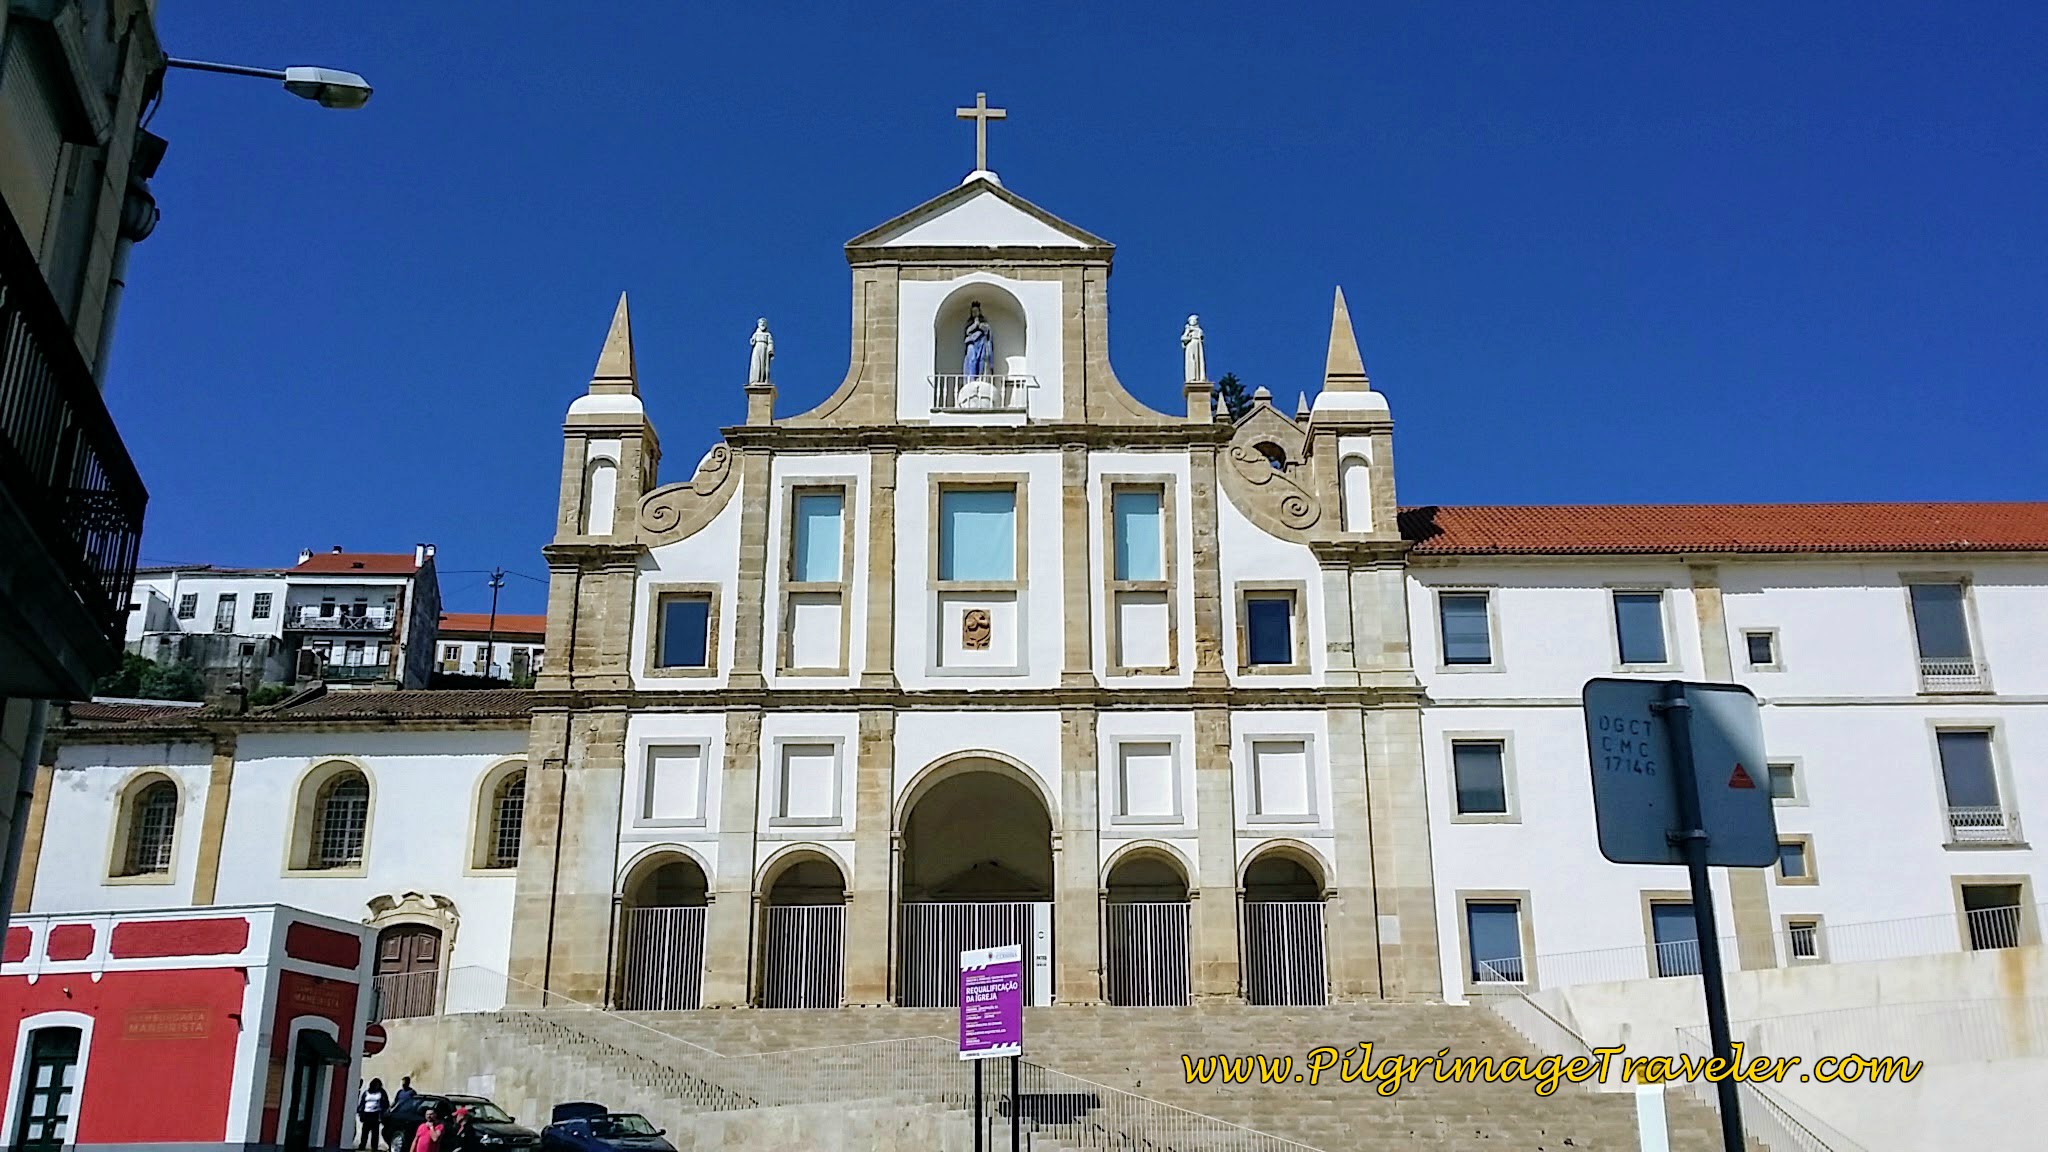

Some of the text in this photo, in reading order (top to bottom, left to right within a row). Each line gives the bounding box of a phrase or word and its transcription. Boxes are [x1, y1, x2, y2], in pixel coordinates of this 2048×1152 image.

[1605, 756, 1656, 776] 17146
[966, 982, 1018, 995] REQUALIFICAÇÃO
[966, 992, 998, 1003] DA IGREJA
